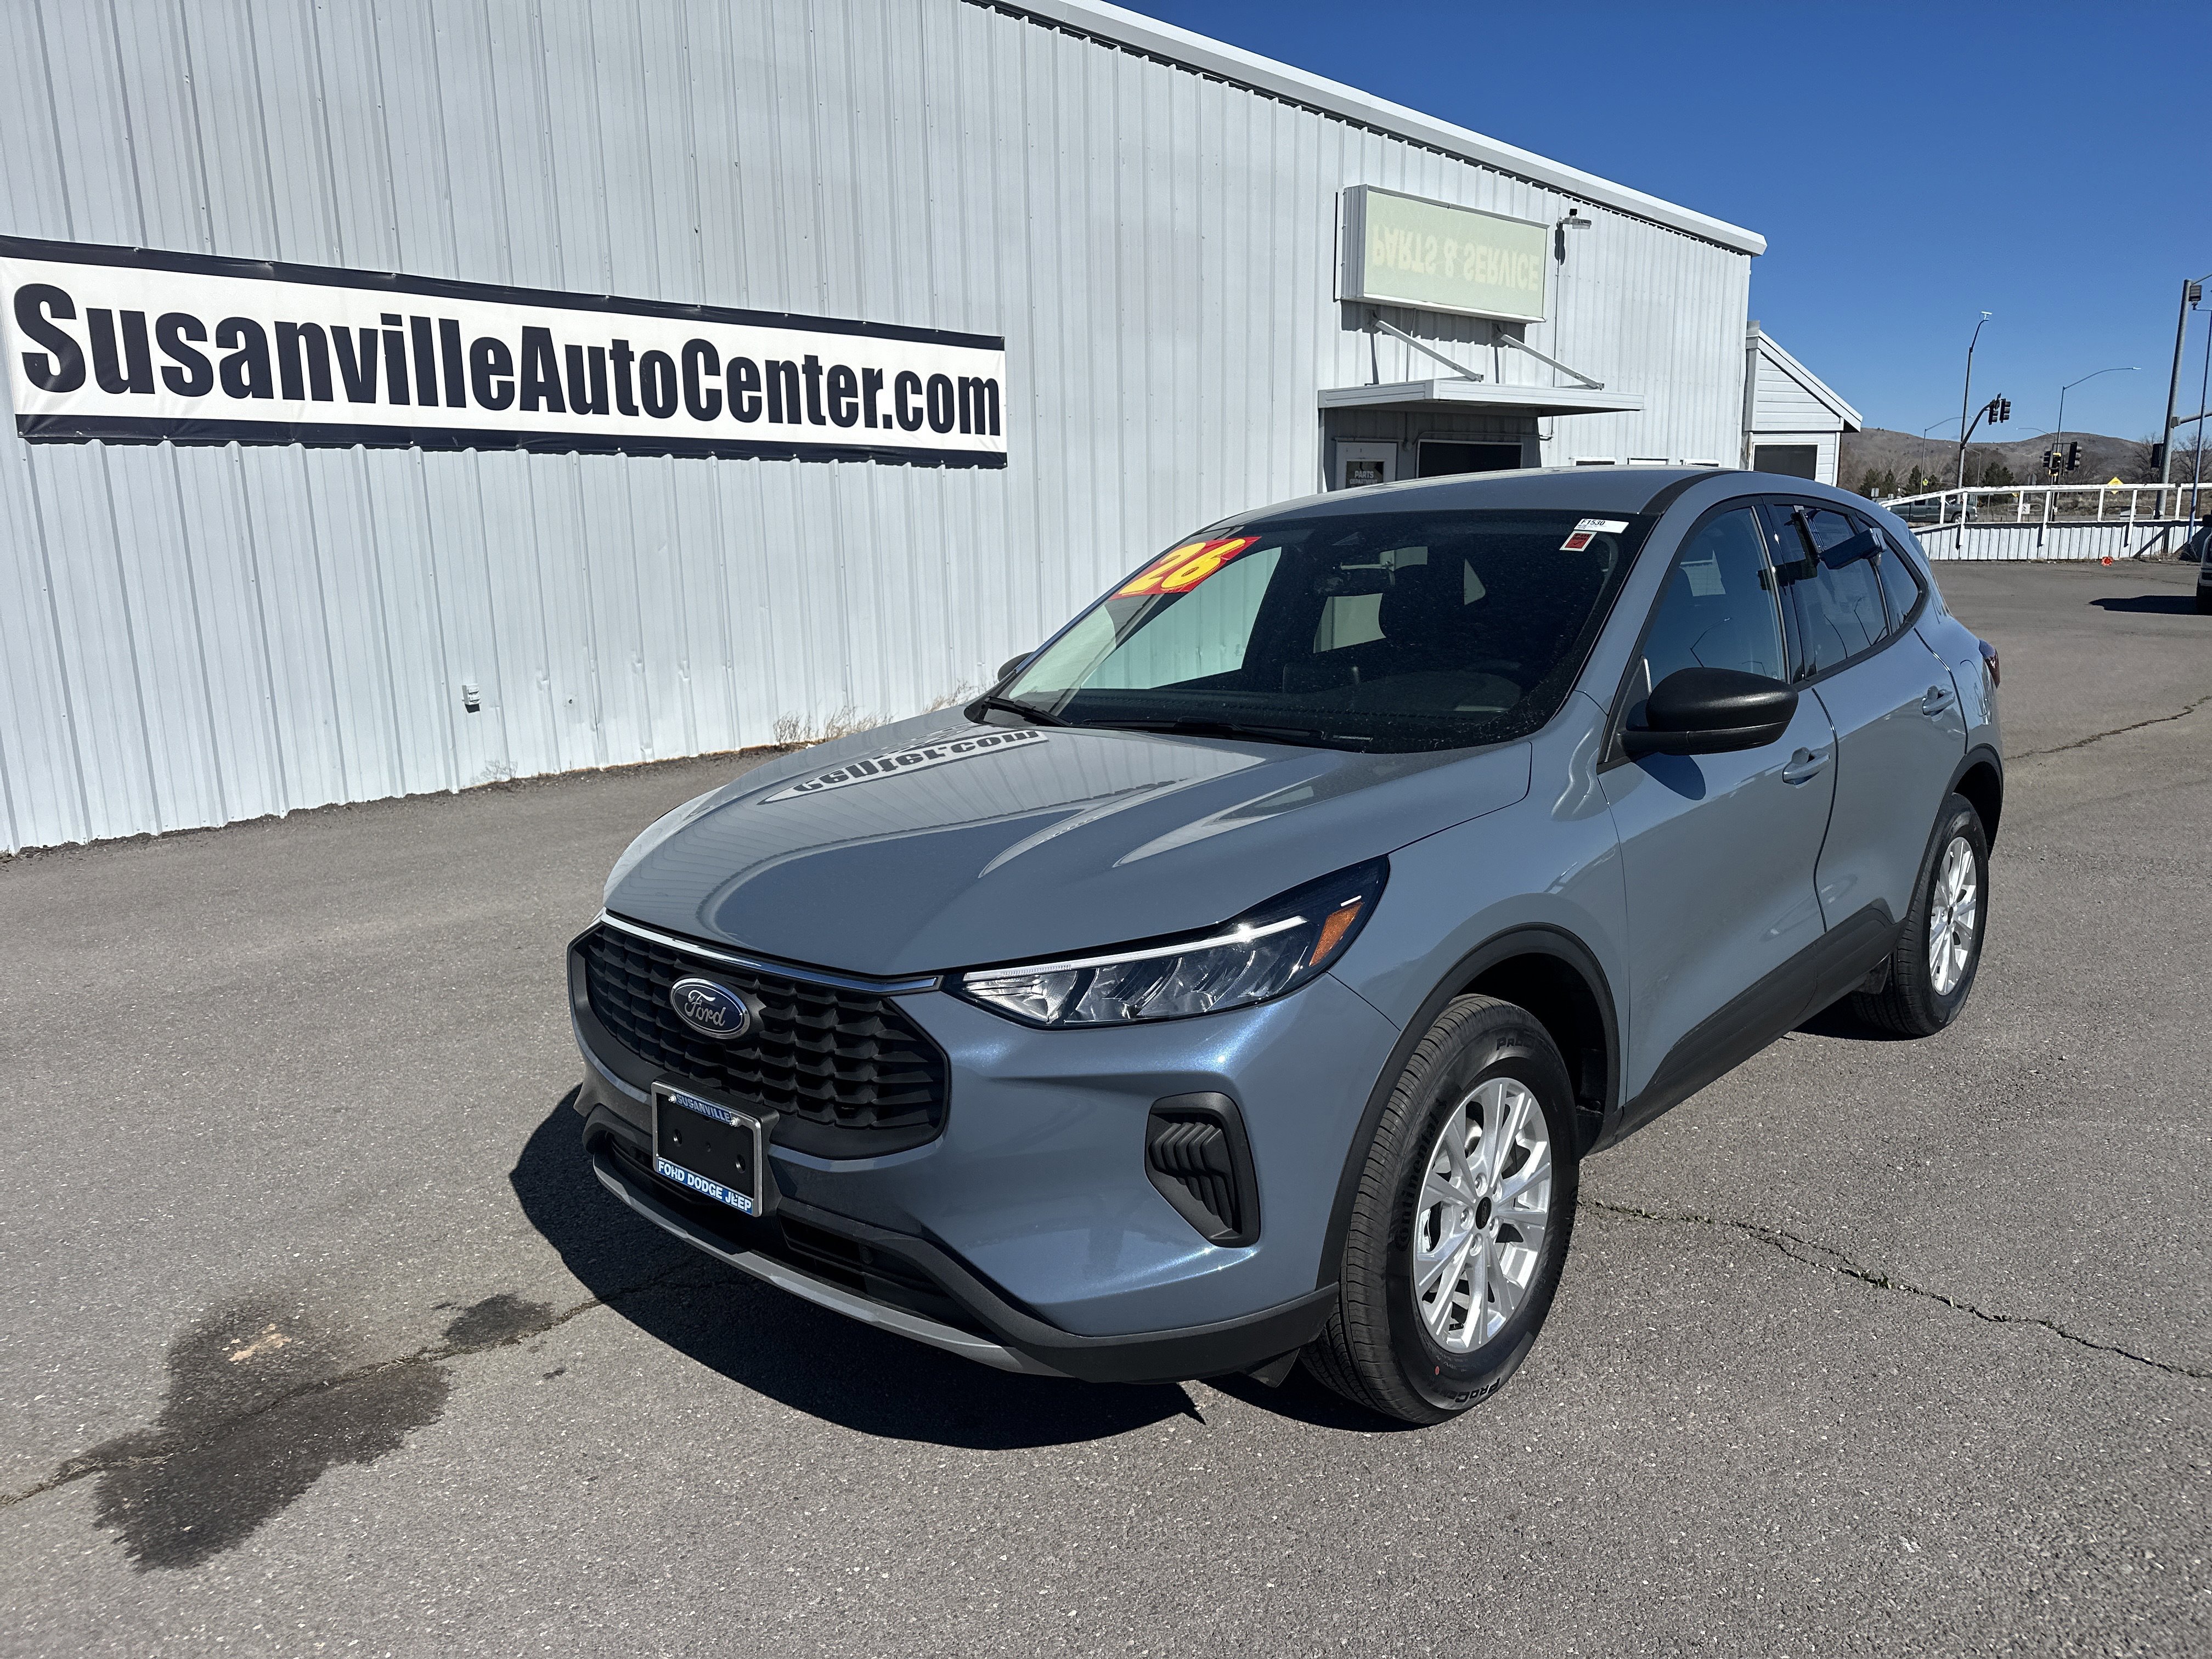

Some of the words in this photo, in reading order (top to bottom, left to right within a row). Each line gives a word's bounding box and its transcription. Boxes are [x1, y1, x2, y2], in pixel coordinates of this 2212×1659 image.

[14, 284, 1001, 436] SusanvilleAutoCenter.com
[1118, 539, 1246, 596] 26
[684, 989, 726, 1027] Ford
[676, 1094, 731, 1122] SUSANVILLE
[658, 1160, 685, 1182] FORD
[687, 1174, 724, 1200] DODGE
[725, 1192, 752, 1211] JEEP
